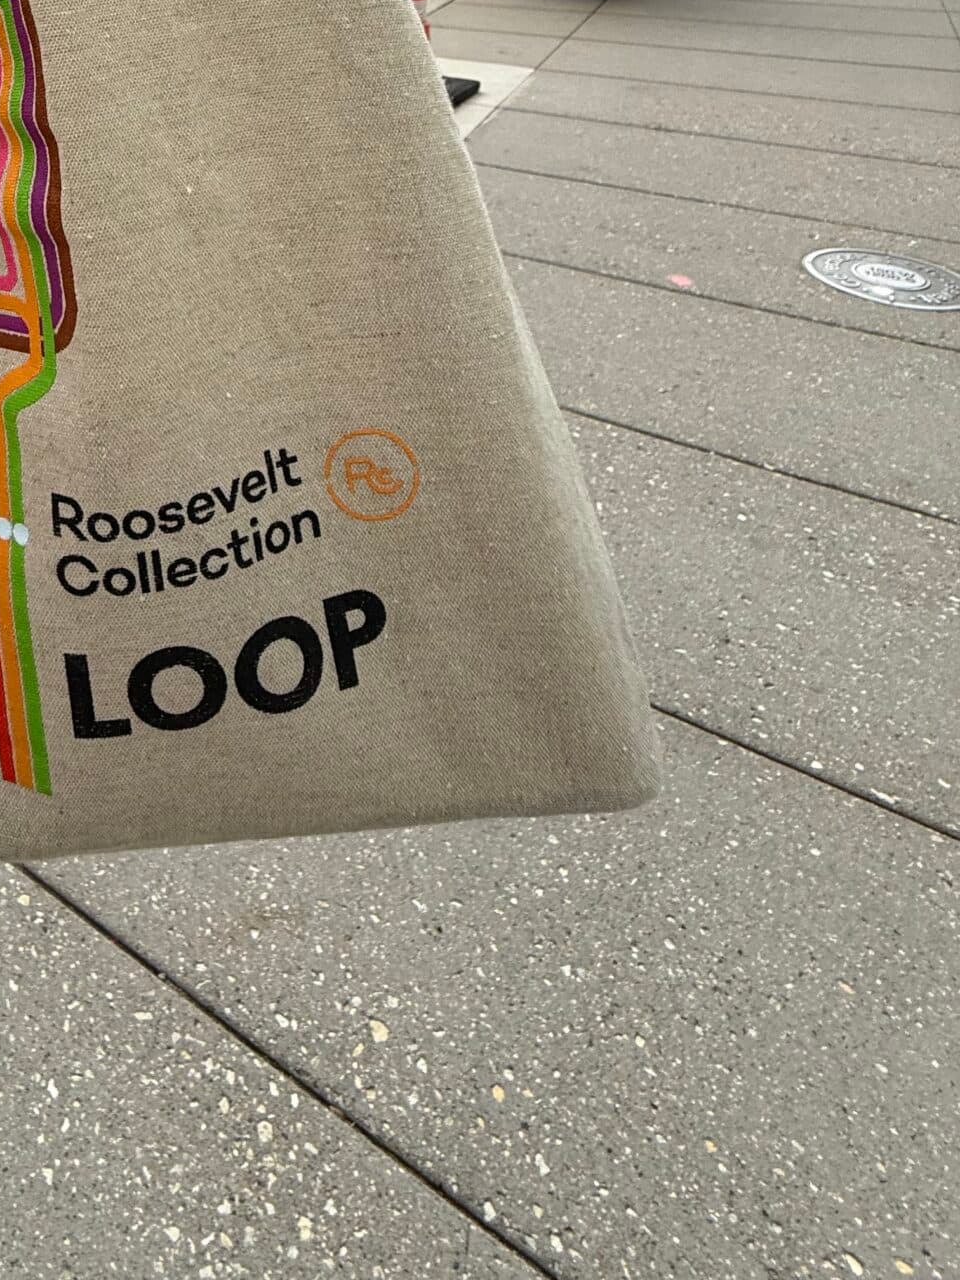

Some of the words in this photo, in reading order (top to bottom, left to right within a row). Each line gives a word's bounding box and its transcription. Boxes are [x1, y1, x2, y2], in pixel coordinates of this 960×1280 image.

[50, 448, 303, 543] Roosevelt
[55, 508, 323, 597] Collection
[63, 589, 387, 739] LOOP
